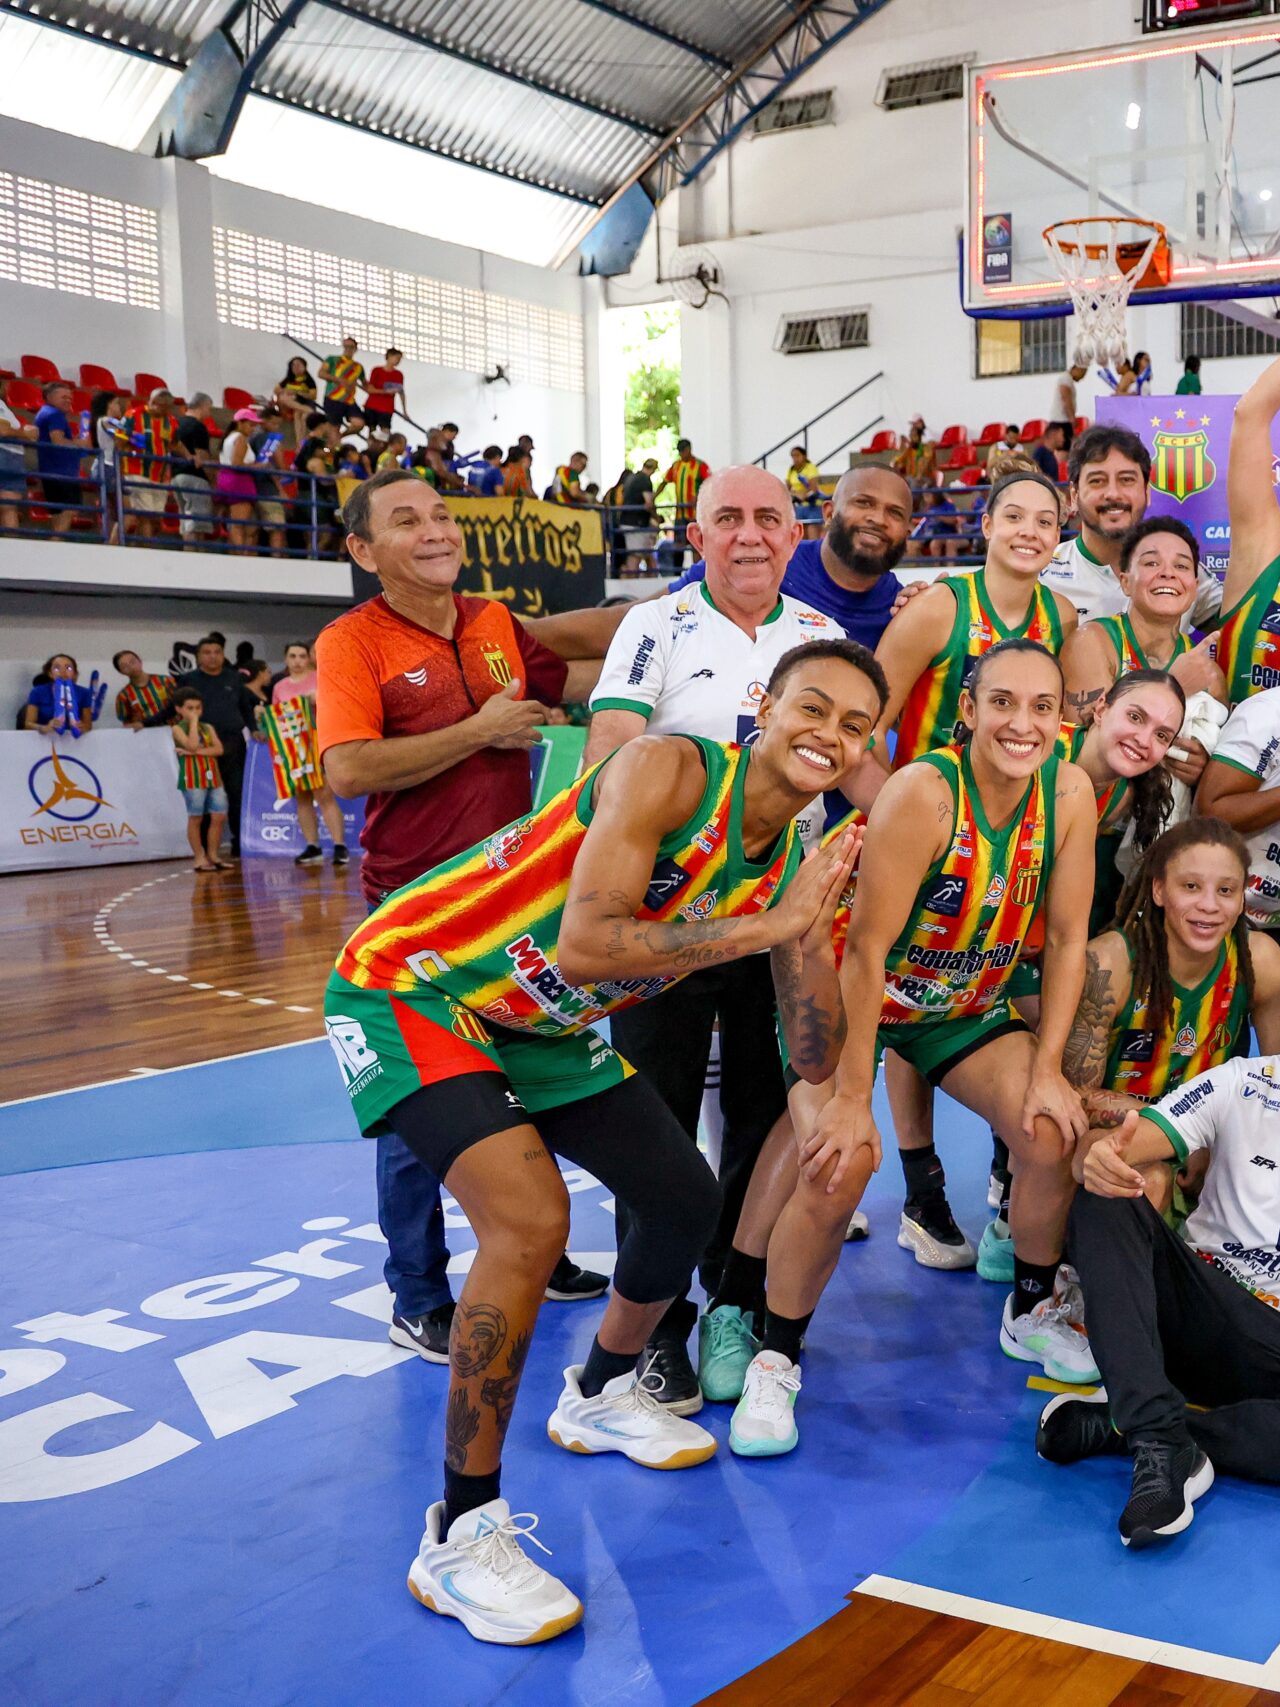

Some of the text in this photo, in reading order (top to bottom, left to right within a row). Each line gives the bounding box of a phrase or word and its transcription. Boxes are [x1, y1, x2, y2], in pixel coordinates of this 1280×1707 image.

[986, 253, 1008, 267] FIBA
[455, 500, 583, 574] rreiros
[1206, 526, 1231, 539] CAI
[20, 822, 137, 846] ENERGIA
[261, 825, 290, 841] CBC
[1250, 1155, 1271, 1168] SF
